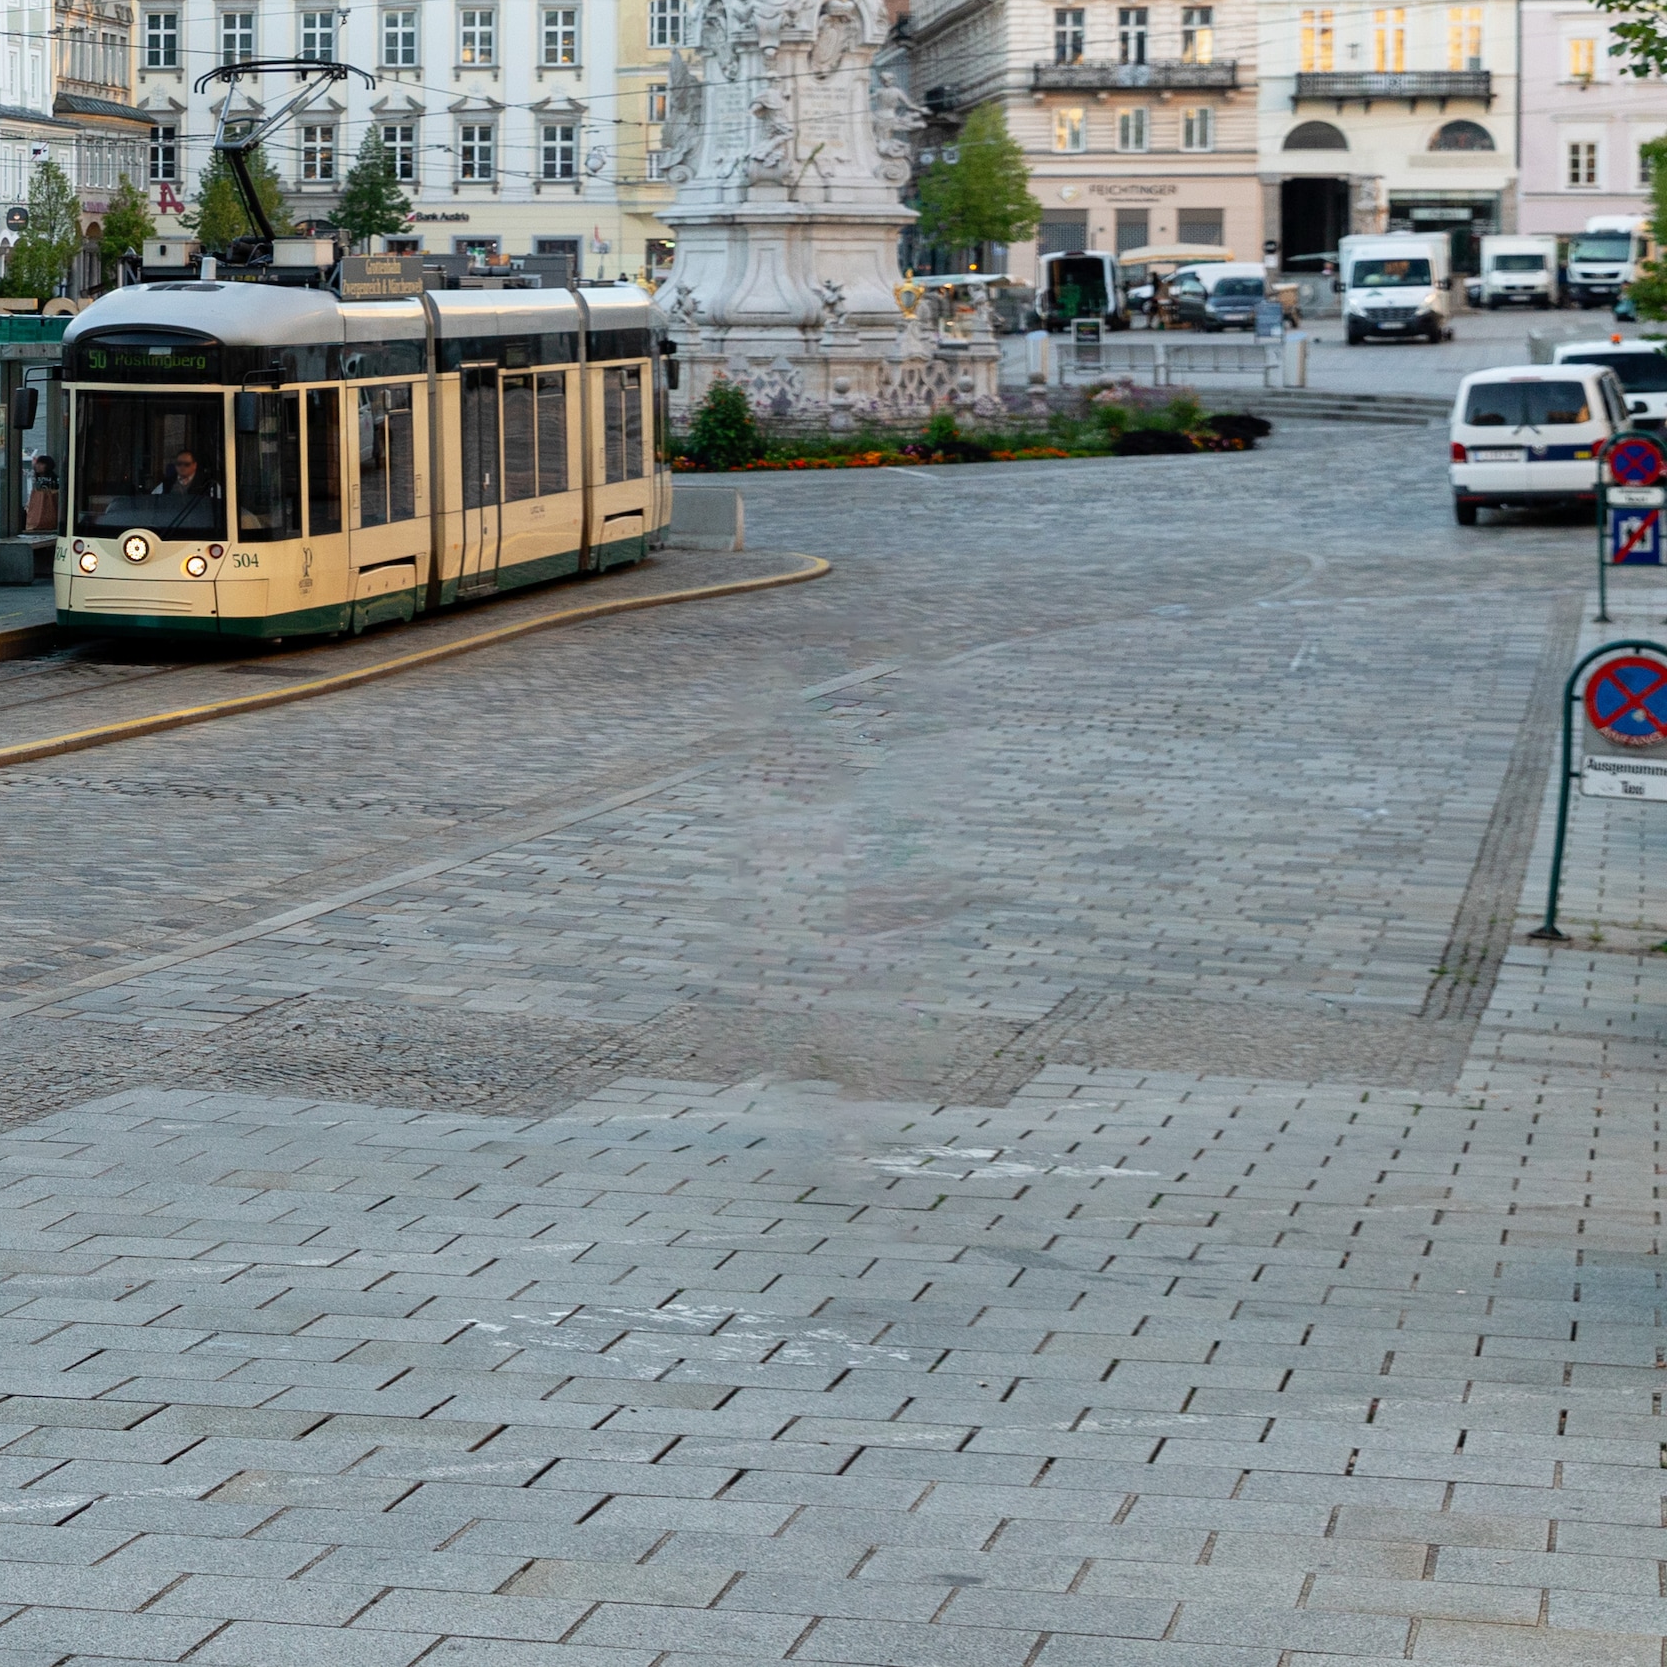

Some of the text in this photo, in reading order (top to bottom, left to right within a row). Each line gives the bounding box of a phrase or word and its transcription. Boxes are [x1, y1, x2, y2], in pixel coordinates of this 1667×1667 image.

[417, 212, 469, 222] Bank Austria
[88, 350, 106, 369] 50
[232, 553, 259, 568] 504
[1620, 780, 1645, 795] Taxi
